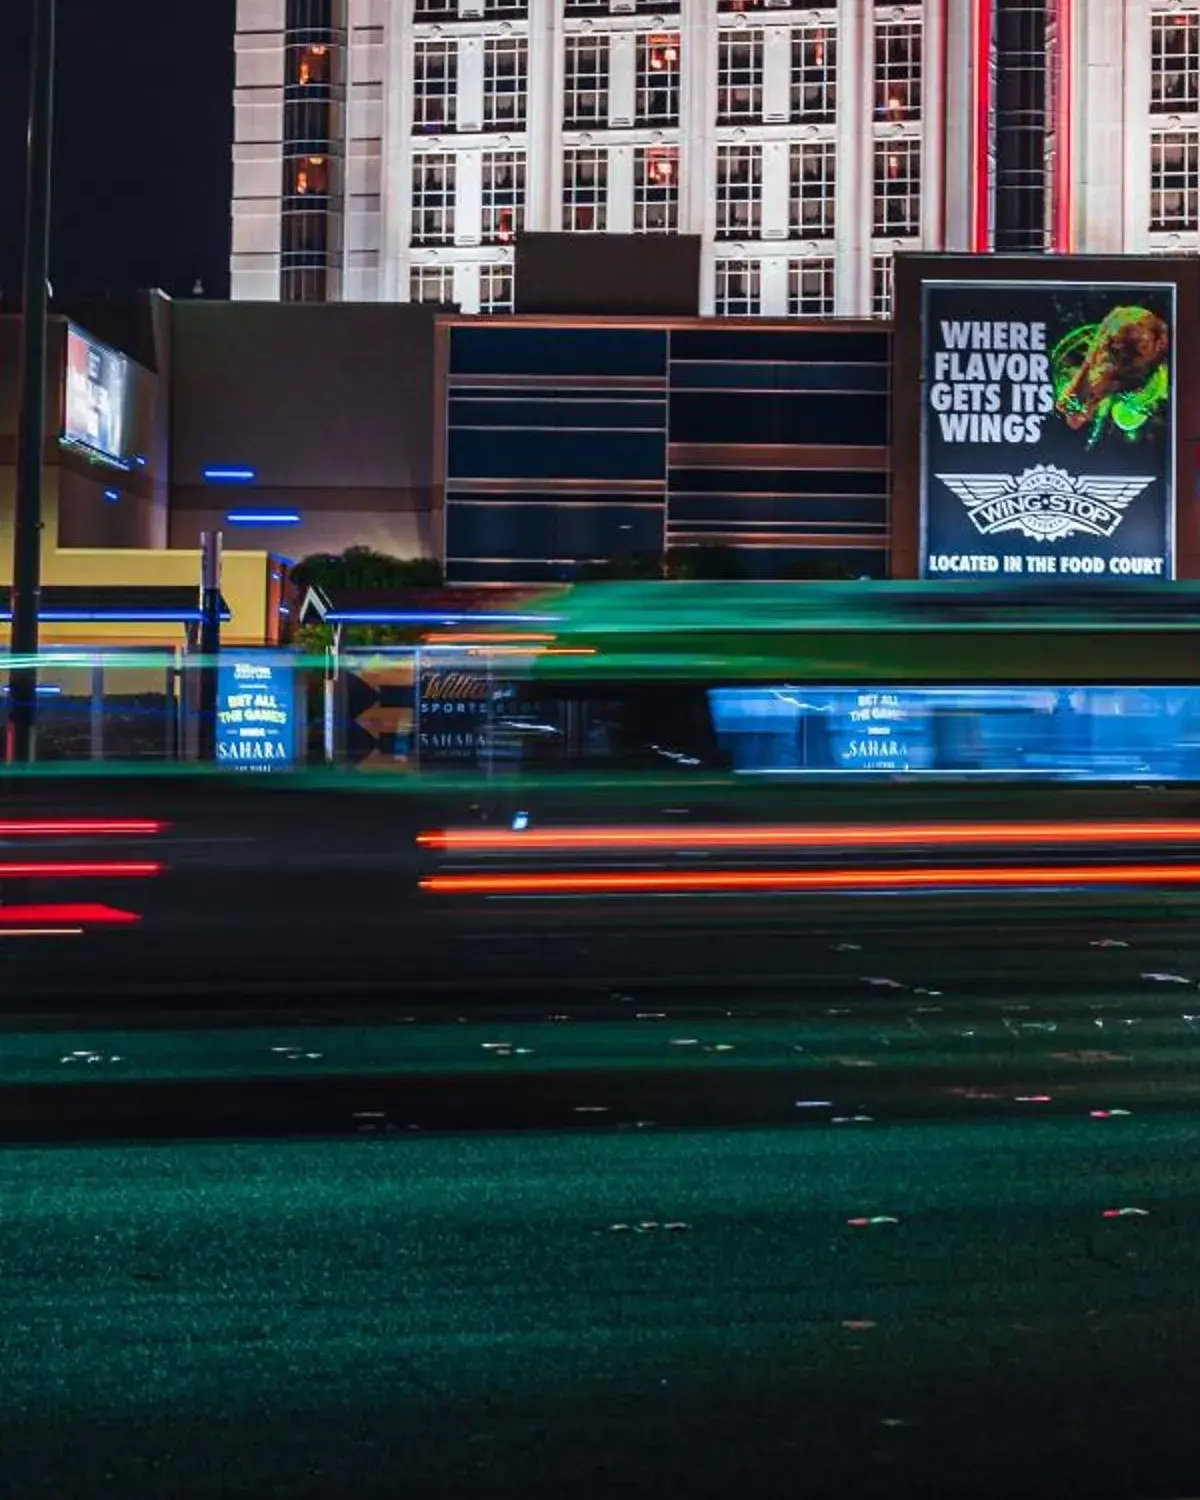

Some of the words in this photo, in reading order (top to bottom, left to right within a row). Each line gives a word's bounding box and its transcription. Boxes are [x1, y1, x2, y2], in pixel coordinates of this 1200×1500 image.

[940, 320, 1047, 351] WHERE
[935, 352, 1049, 382] FLAVOR
[931, 383, 1001, 412] GETS
[1012, 383, 1053, 413] ITS
[938, 413, 1043, 443] WINGS
[929, 554, 999, 573] LOCATED
[1003, 555, 1023, 573] IN
[1026, 556, 1057, 573] THE
[1059, 557, 1106, 574] FOOD
[1108, 557, 1164, 575] COURT
[254, 694, 277, 709] ALL
[217, 741, 287, 759] SAHARA
